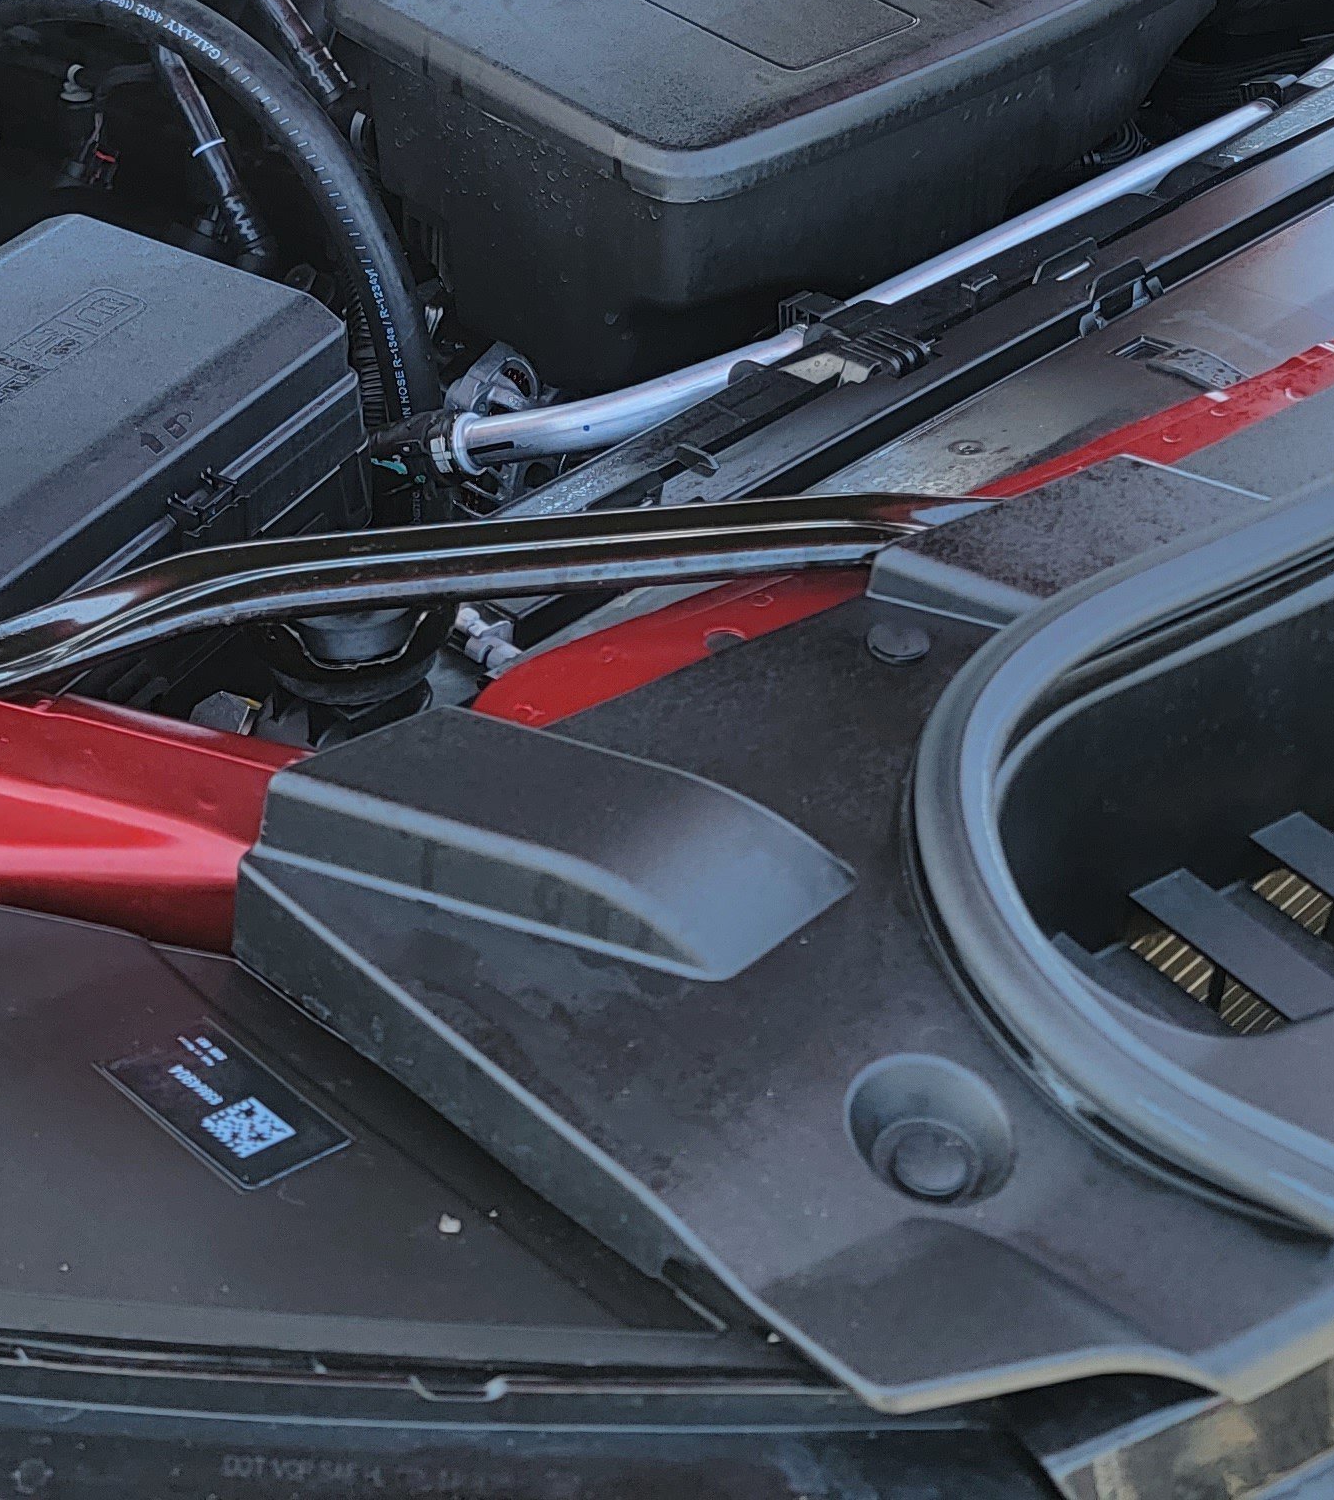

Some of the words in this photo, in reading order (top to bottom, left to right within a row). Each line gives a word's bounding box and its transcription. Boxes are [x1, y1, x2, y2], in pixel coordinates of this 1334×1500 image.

[136, 3, 164, 25] 4882
[163, 18, 222, 60] GALAXY
[386, 327, 403, 368] R-134a
[396, 369, 409, 405] HOSE
